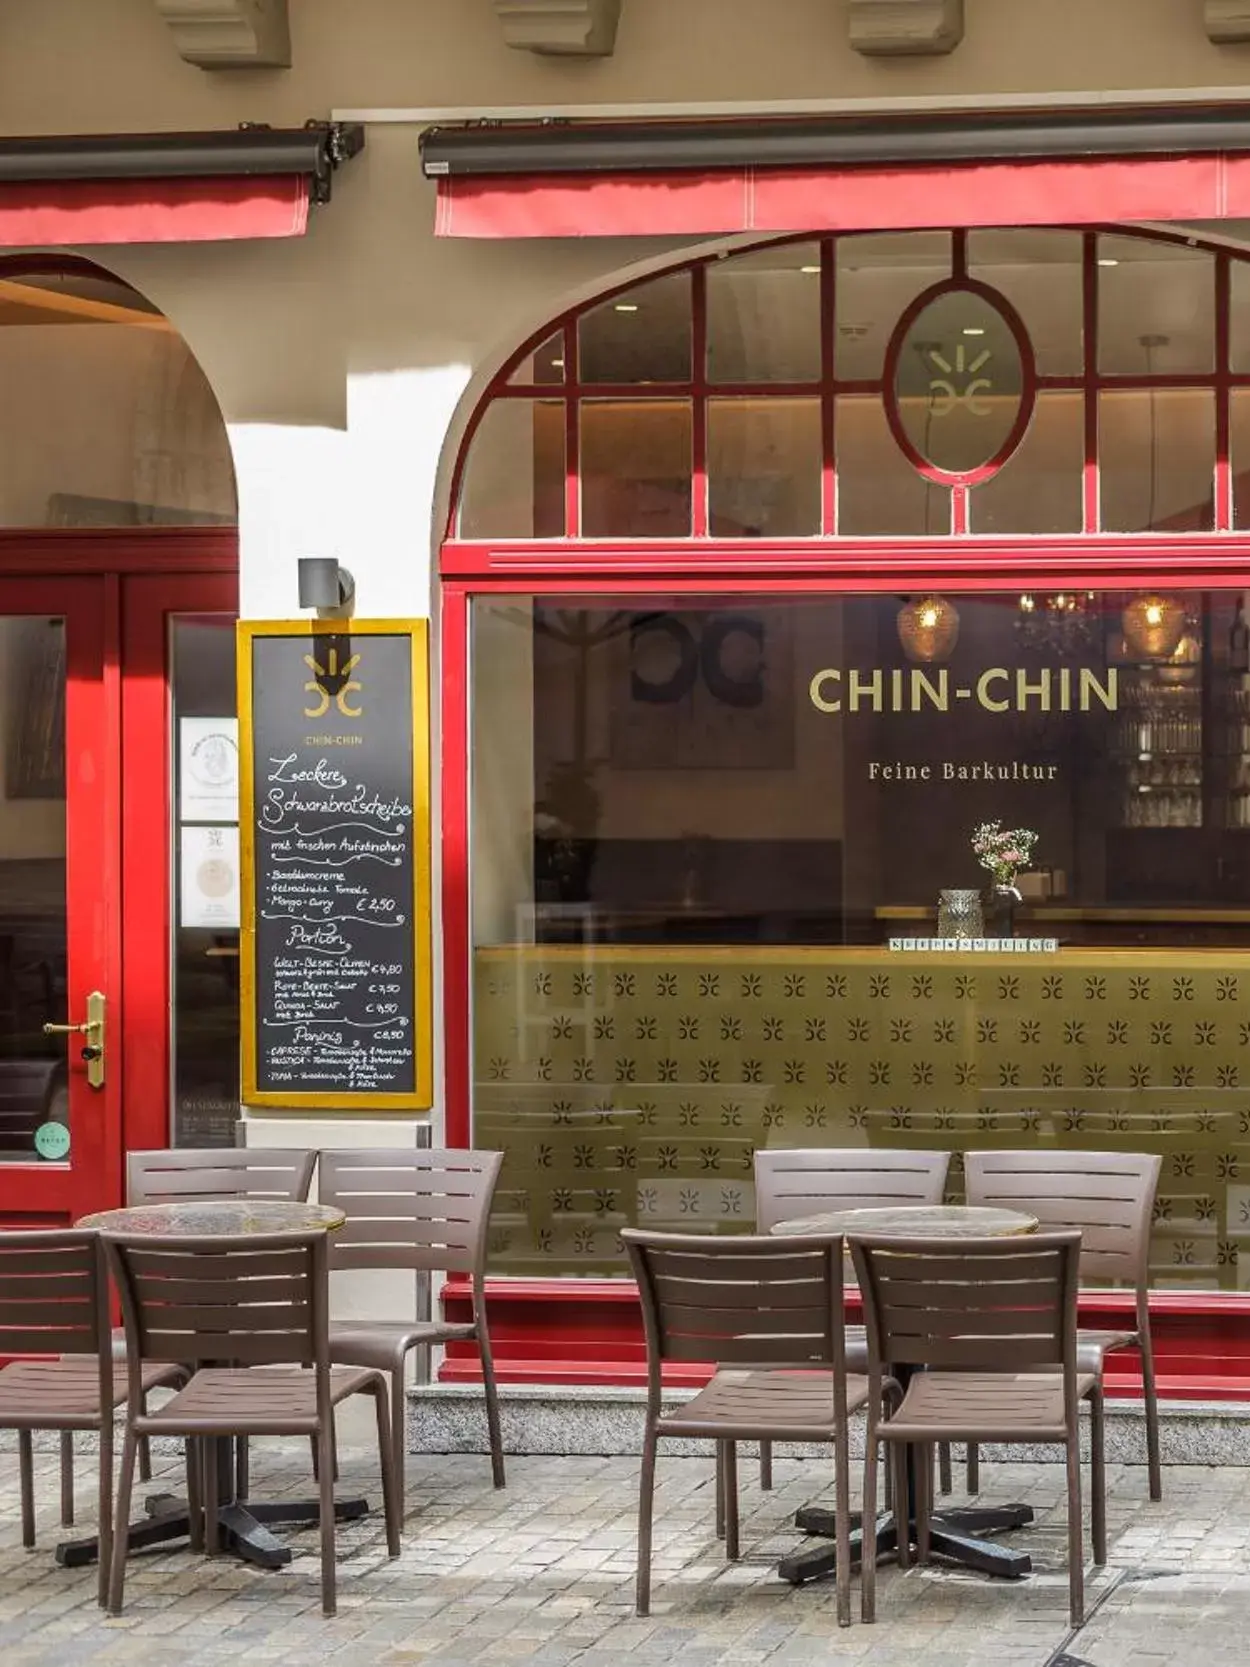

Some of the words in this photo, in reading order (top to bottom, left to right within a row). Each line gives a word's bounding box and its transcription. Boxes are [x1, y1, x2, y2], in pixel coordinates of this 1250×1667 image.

[809, 668, 1118, 712] CHIN-CHIN
[305, 735, 363, 746] CHIN-CHIN
[869, 762, 931, 780] Feine
[944, 762, 1059, 780] Barkultur
[285, 923, 346, 946] Portion
